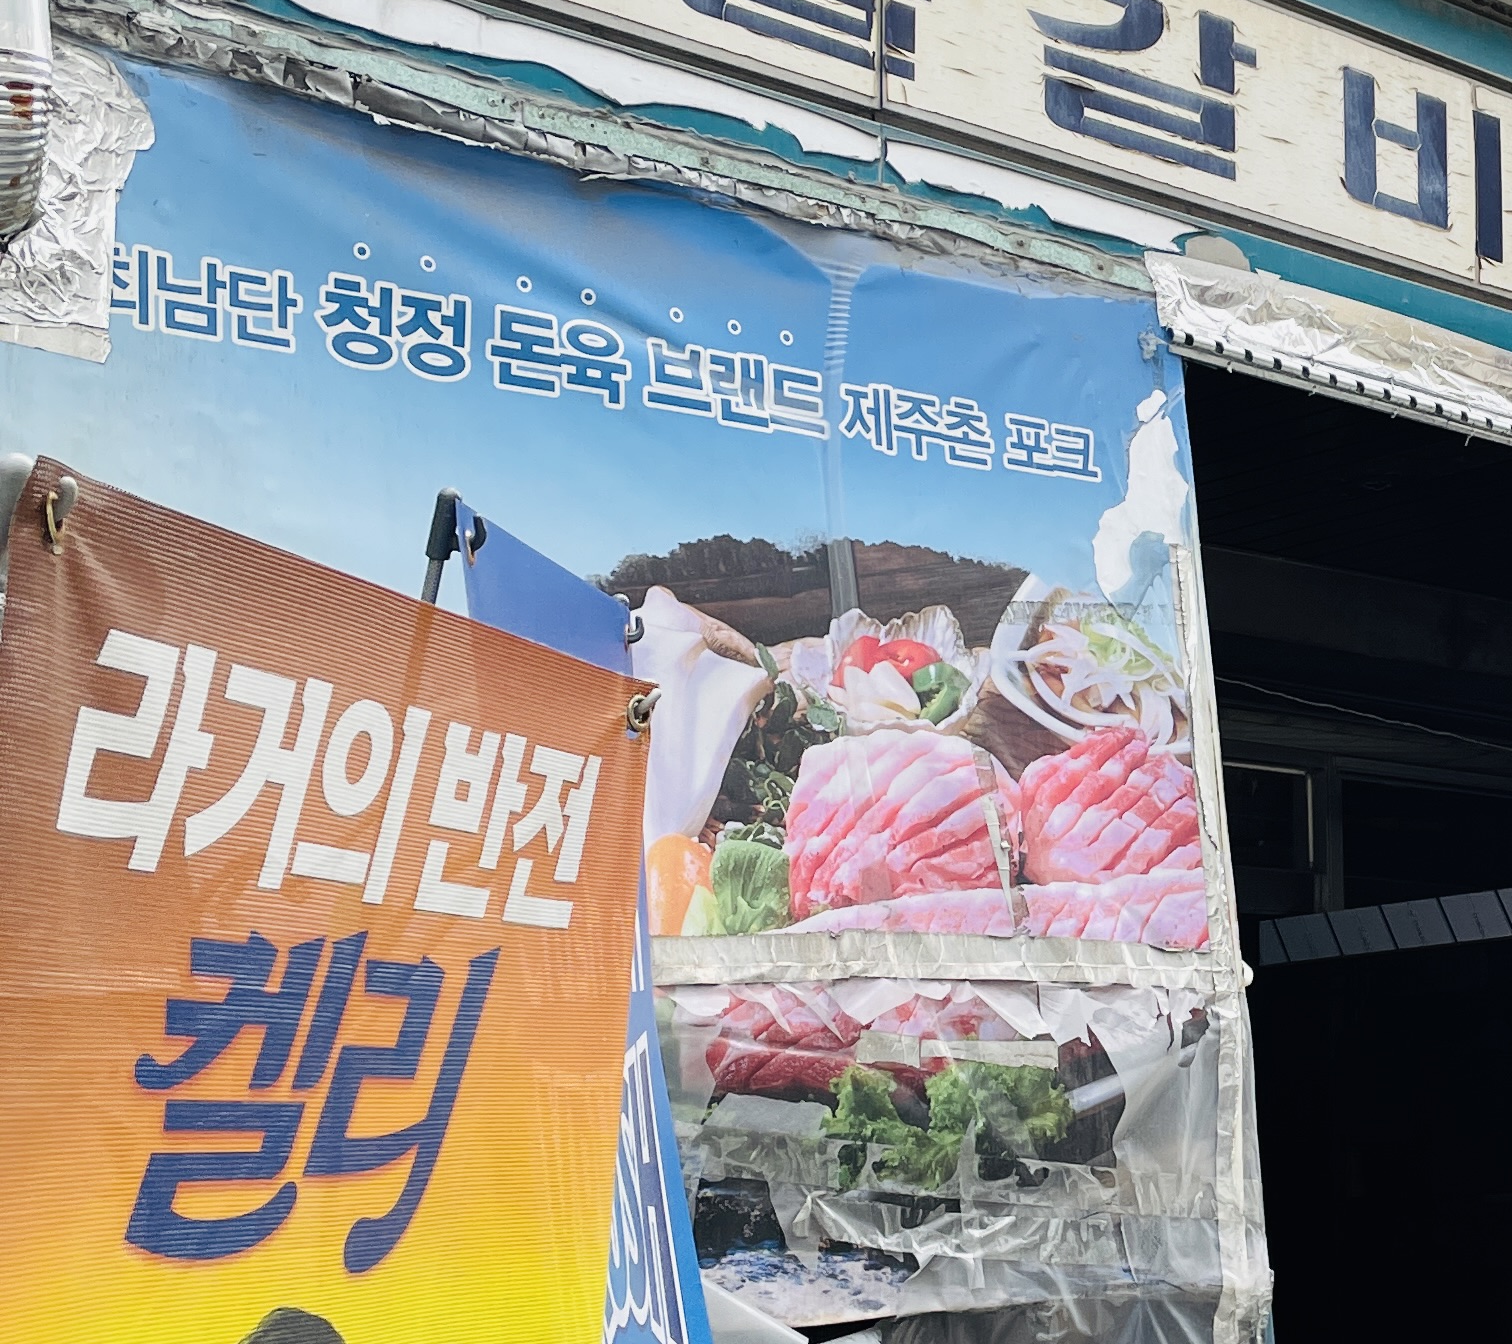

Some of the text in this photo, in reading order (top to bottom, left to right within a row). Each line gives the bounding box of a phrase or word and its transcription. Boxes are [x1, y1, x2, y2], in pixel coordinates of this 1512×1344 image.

[316, 271, 472, 382] 청정
[486, 302, 632, 410] 돈육
[643, 337, 830, 439] 브랜드
[839, 382, 995, 471] 제주촌
[1002, 411, 1103, 482] 포크
[124, 930, 502, 1274] 켈리
